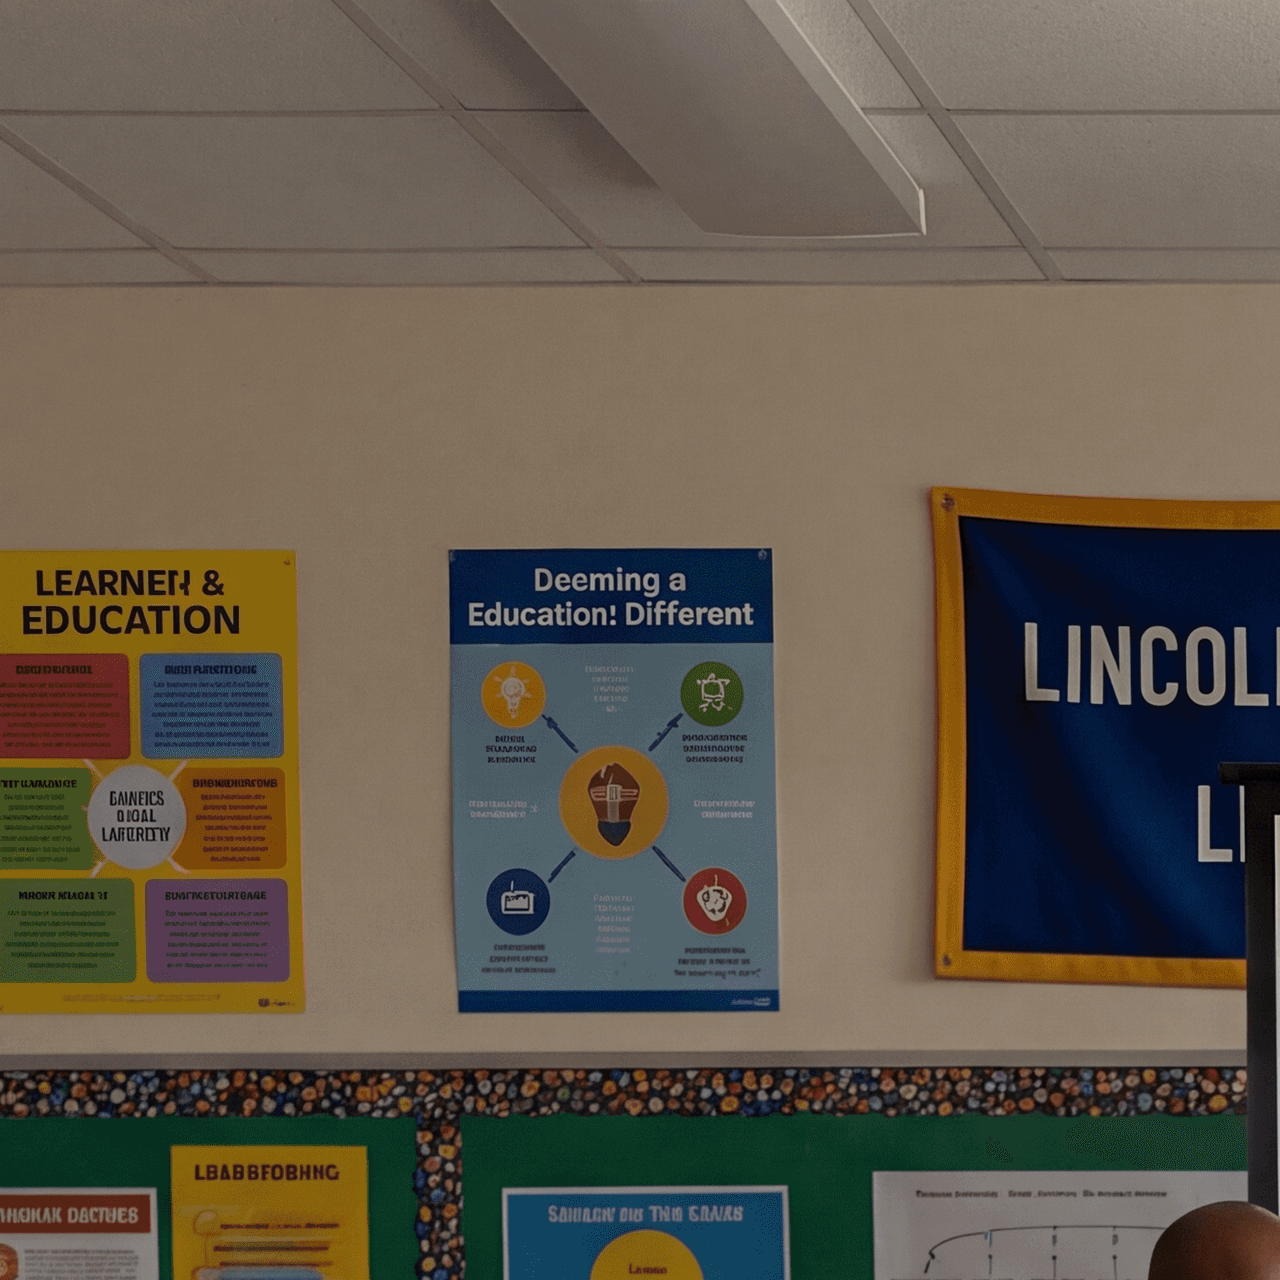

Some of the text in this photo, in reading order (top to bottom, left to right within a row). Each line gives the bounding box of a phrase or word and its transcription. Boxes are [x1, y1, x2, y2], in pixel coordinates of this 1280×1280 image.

[202, 569, 225, 596] &
[534, 566, 687, 598] Deeming a
[22, 604, 240, 635] EDUCATION
[468, 599, 754, 627] Education! Different
